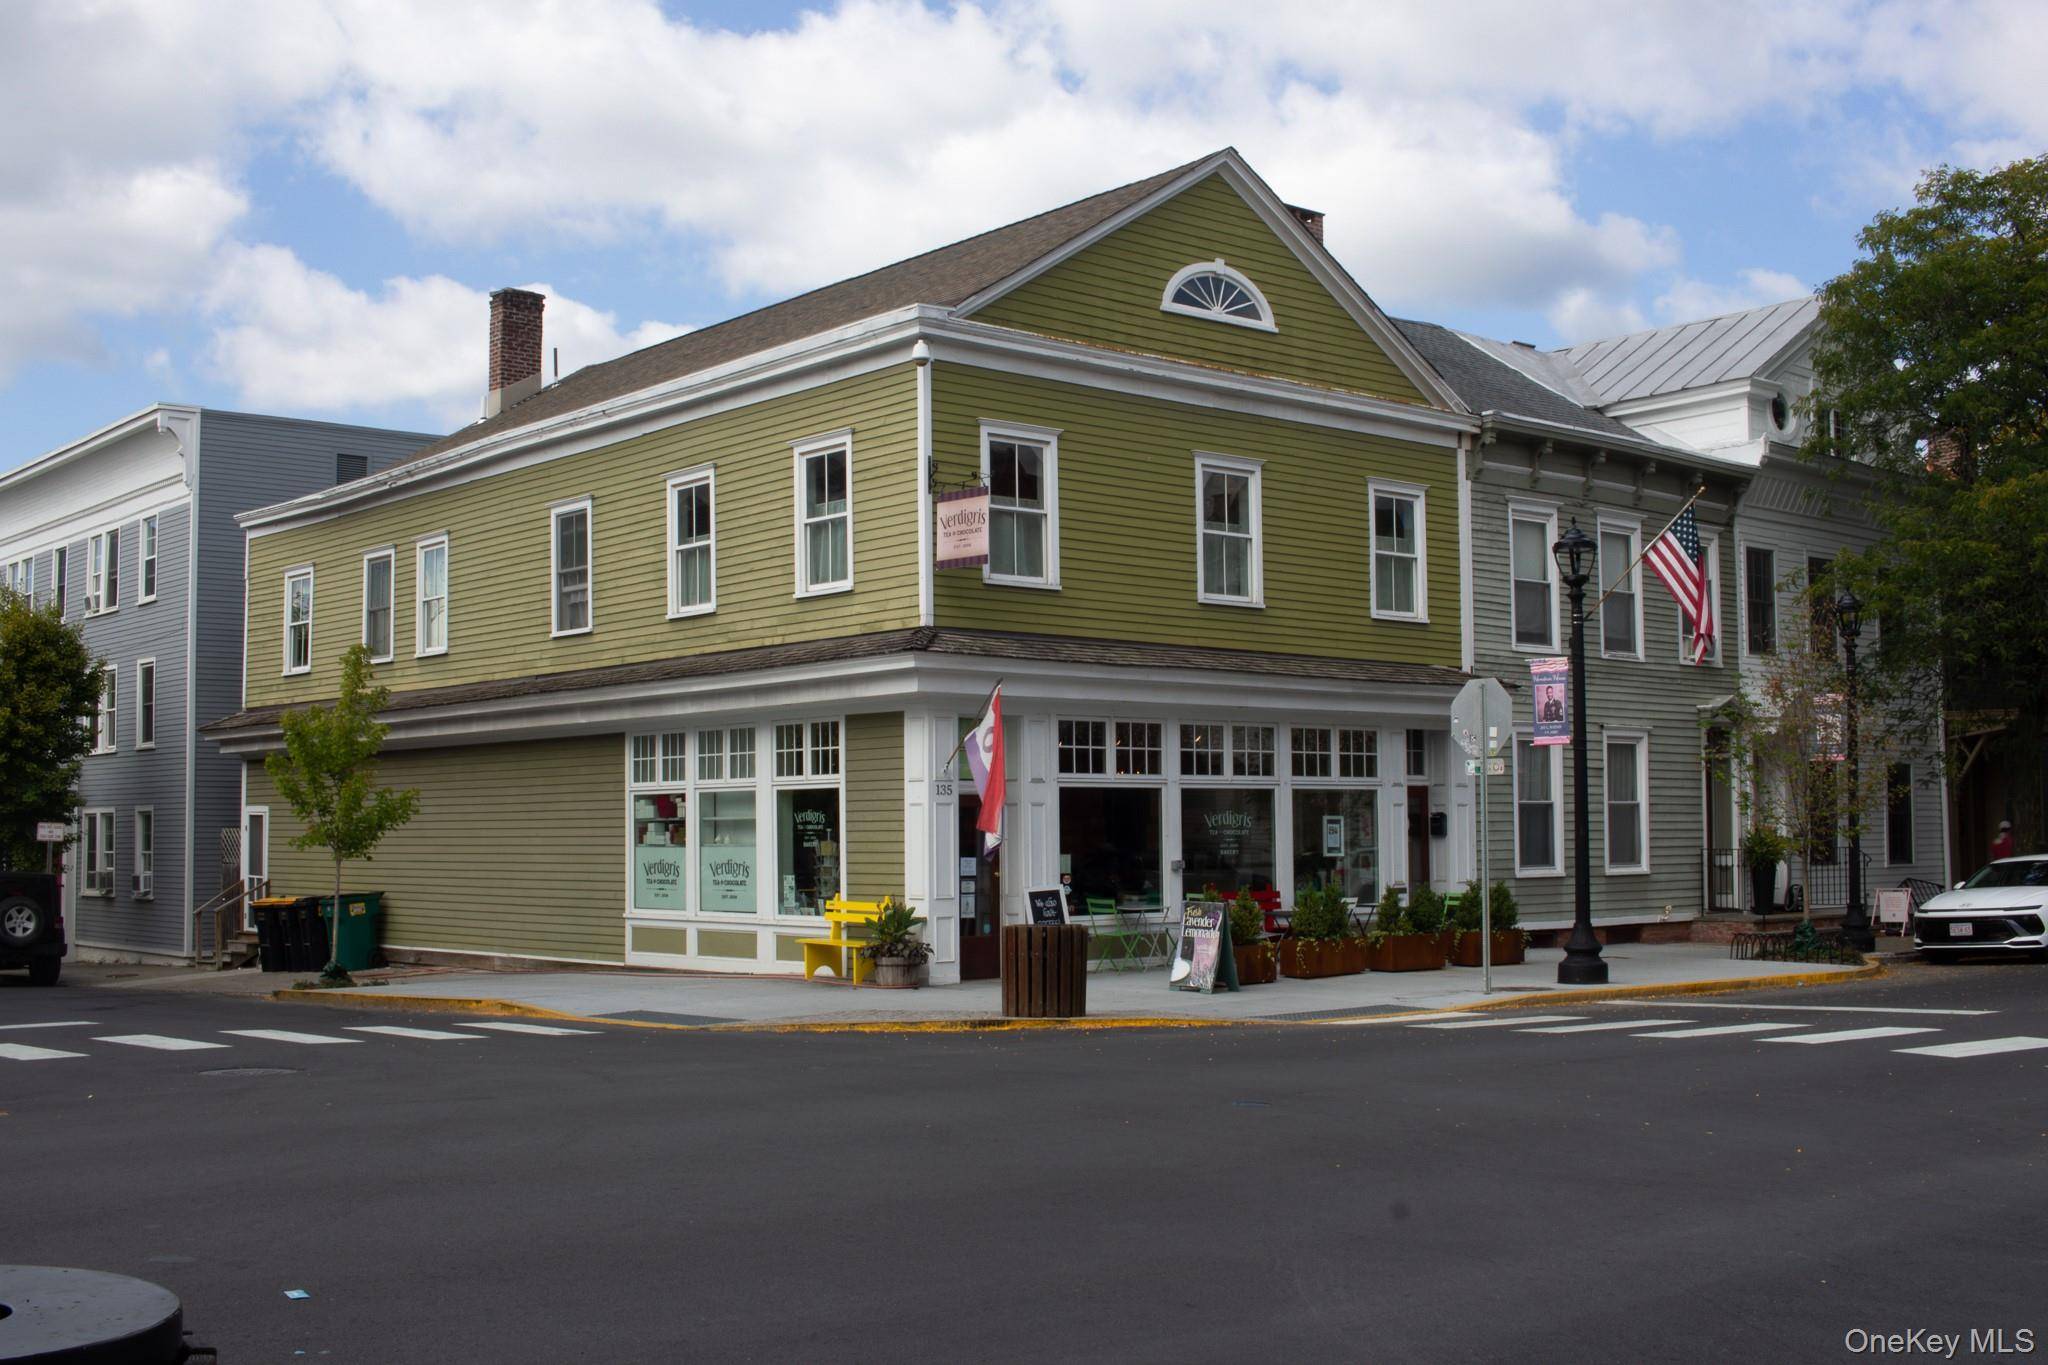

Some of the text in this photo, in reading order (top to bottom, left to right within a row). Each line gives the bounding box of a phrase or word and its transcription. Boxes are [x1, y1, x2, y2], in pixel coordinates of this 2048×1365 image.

[940, 508, 986, 530] Verdigris
[956, 527, 982, 536] CHOCOLATE
[936, 784, 953, 795] 135
[794, 810, 826, 824] Verdigris
[1203, 810, 1252, 828] Verdigris
[643, 859, 680, 877] Verdigris
[709, 859, 750, 879] Verdigris
[1183, 912, 1215, 928] Lavender
